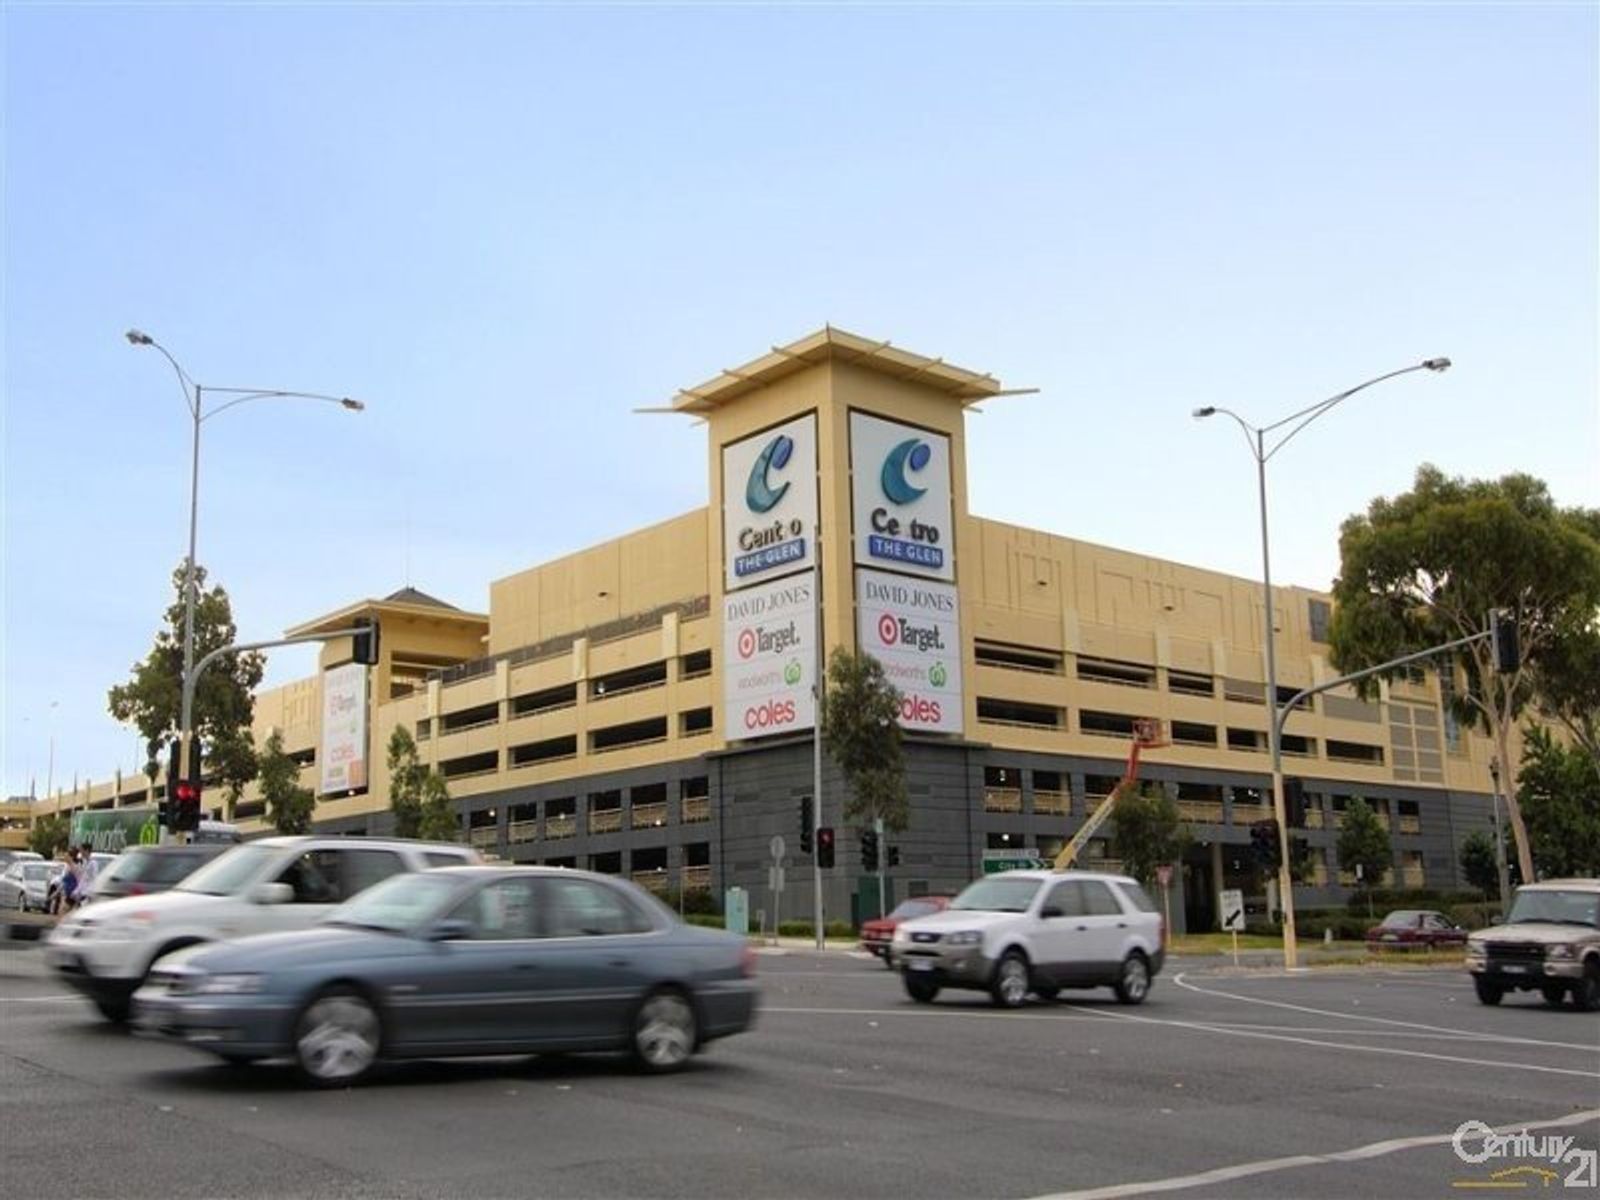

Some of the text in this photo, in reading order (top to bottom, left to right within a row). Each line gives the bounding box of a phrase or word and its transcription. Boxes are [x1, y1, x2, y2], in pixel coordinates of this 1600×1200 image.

[871, 507, 940, 544] Cetro
[737, 541, 801, 573] THE GLEN
[874, 539, 942, 564] THE GLEN
[727, 586, 810, 621] DAVID JONES
[865, 581, 954, 611] DAVID JONES
[745, 699, 796, 730] coles
